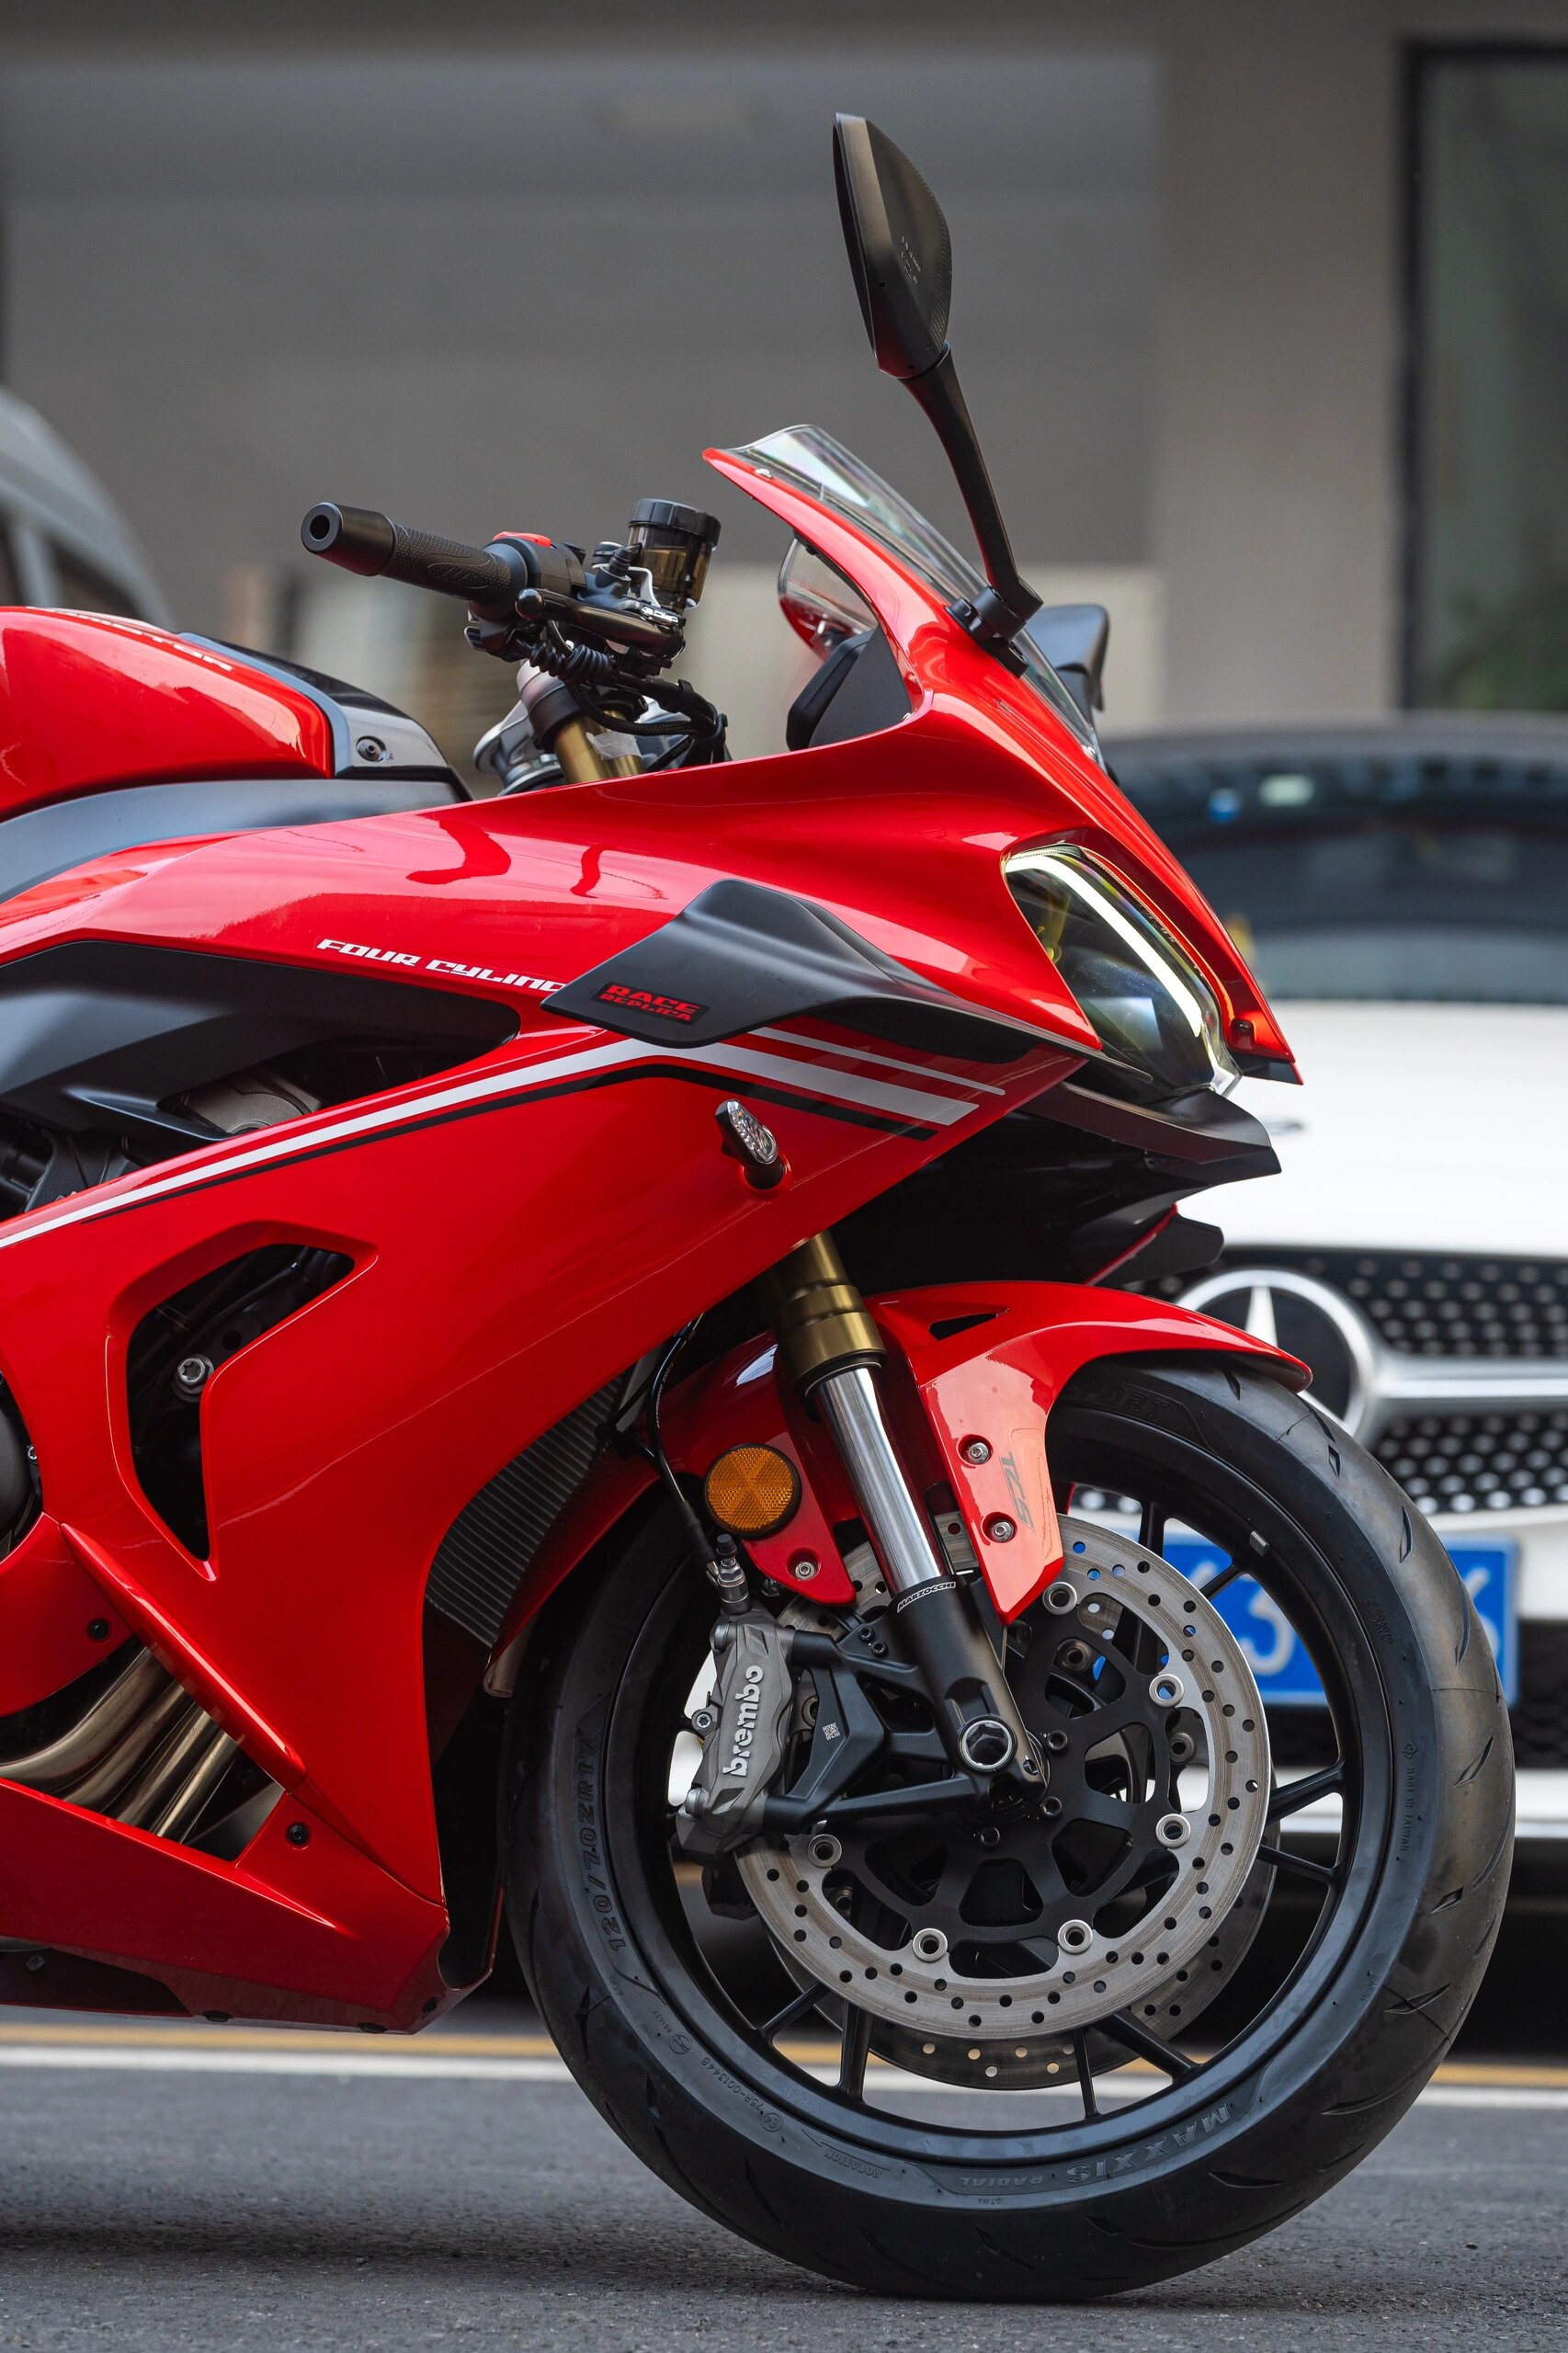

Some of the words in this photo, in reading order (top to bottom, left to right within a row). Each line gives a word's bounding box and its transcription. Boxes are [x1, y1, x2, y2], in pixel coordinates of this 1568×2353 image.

[316, 938, 422, 967] FOUR
[599, 994, 691, 1021] REPLICA
[606, 984, 701, 1015] RACE
[897, 1581, 957, 1614] MARZOCCHI
[722, 1665, 764, 1777] brembo
[1066, 2103, 1232, 2183] MAXXIS
[824, 2149, 883, 2179] ROTATION
[960, 2175, 1043, 2187] RADIAL
